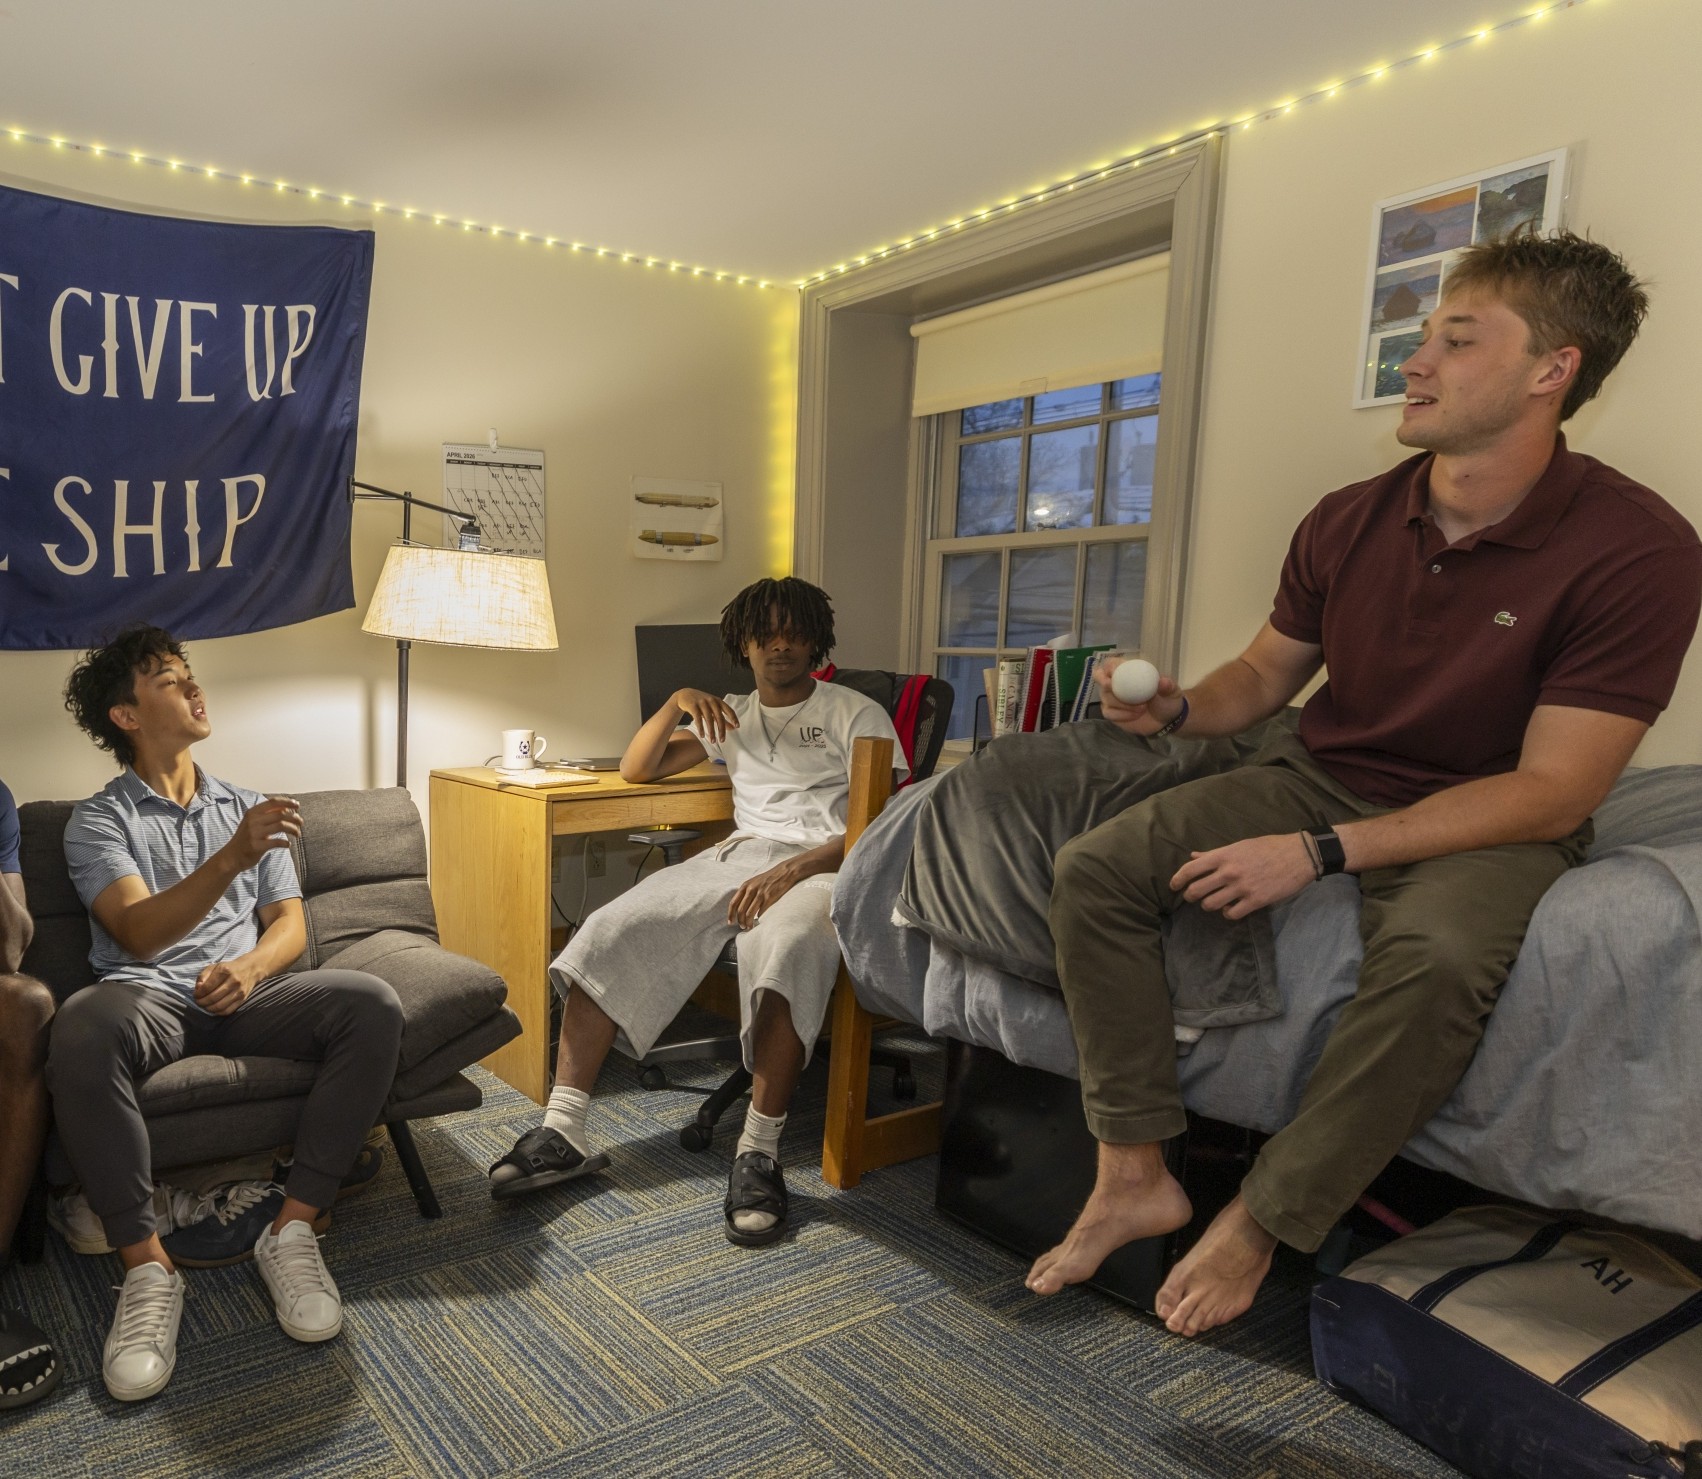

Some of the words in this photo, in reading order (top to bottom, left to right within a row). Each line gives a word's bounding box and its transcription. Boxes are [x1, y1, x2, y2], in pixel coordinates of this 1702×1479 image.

[50, 286, 217, 403] GIVE
[242, 303, 317, 402] UP
[41, 473, 266, 578] SHIP
[997, 688, 1006, 724] SIBLEY
[1005, 685, 1016, 729] CANOES
[1581, 1256, 1634, 1295] AH
